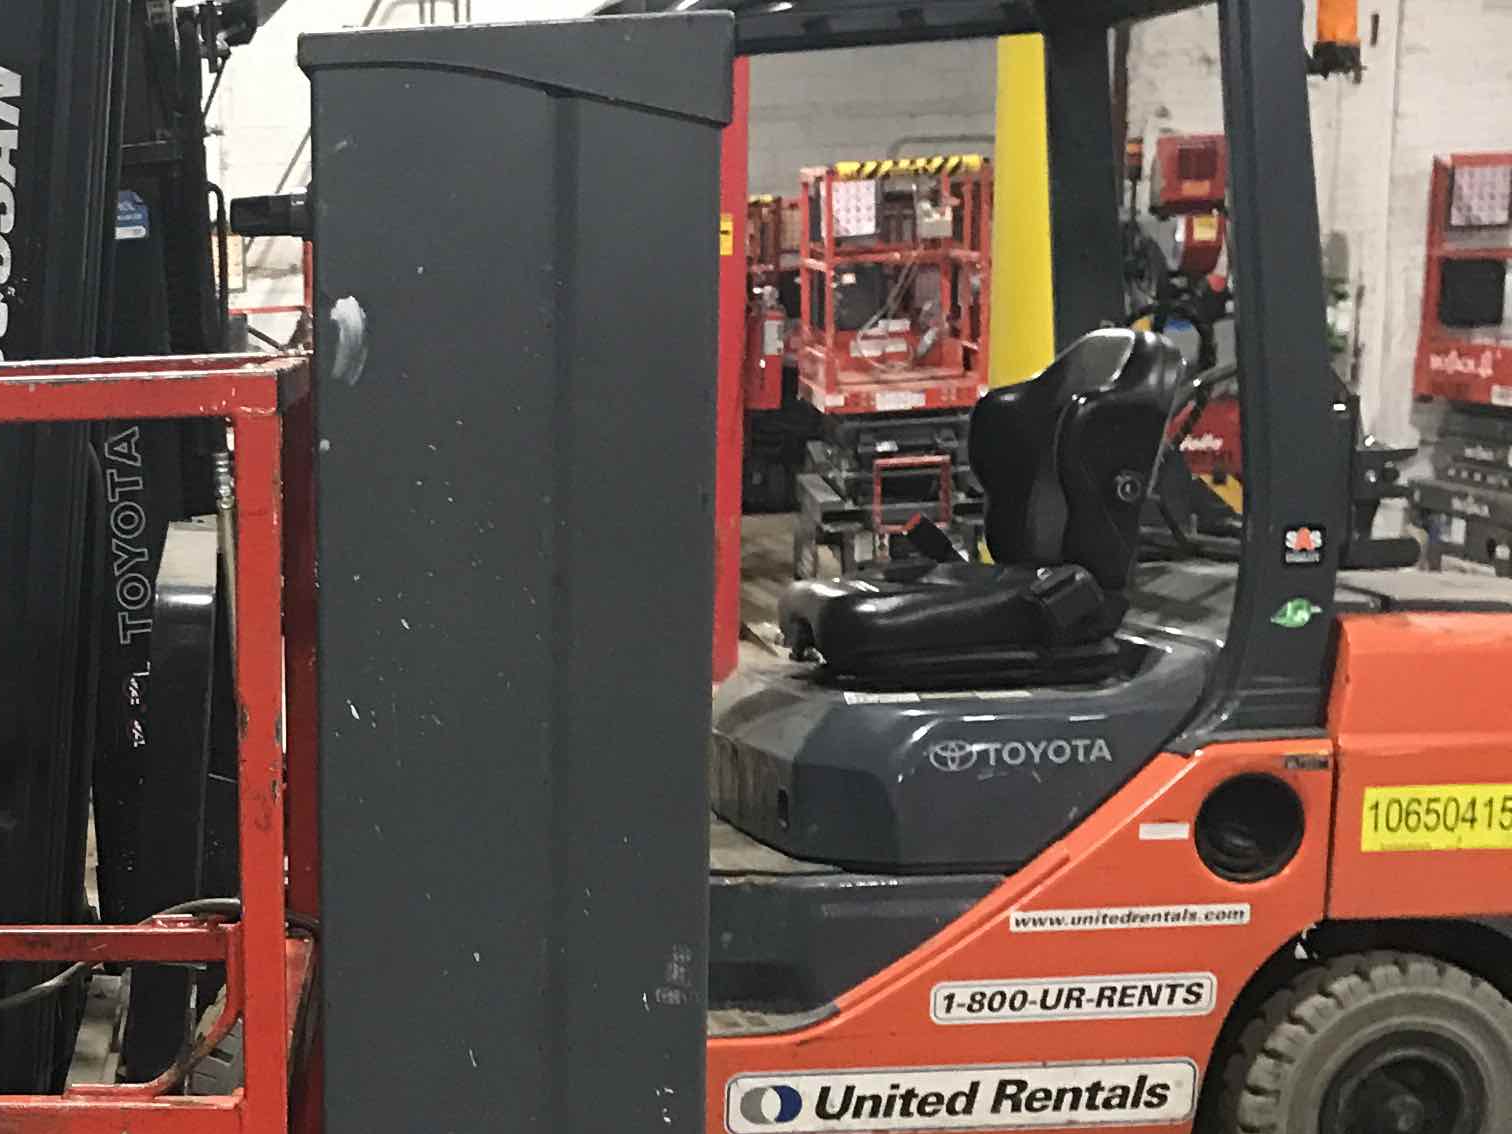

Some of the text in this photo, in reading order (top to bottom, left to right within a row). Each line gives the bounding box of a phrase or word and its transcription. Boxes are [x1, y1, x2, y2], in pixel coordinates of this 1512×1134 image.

[104, 426, 153, 645] TOYOTA
[986, 738, 1113, 766] TOYOTA
[1014, 908, 1245, 928] www.unitedrentals.com
[942, 981, 1205, 1014] 1-800-UR-RENTS
[815, 1074, 1171, 1121] United Rentals
